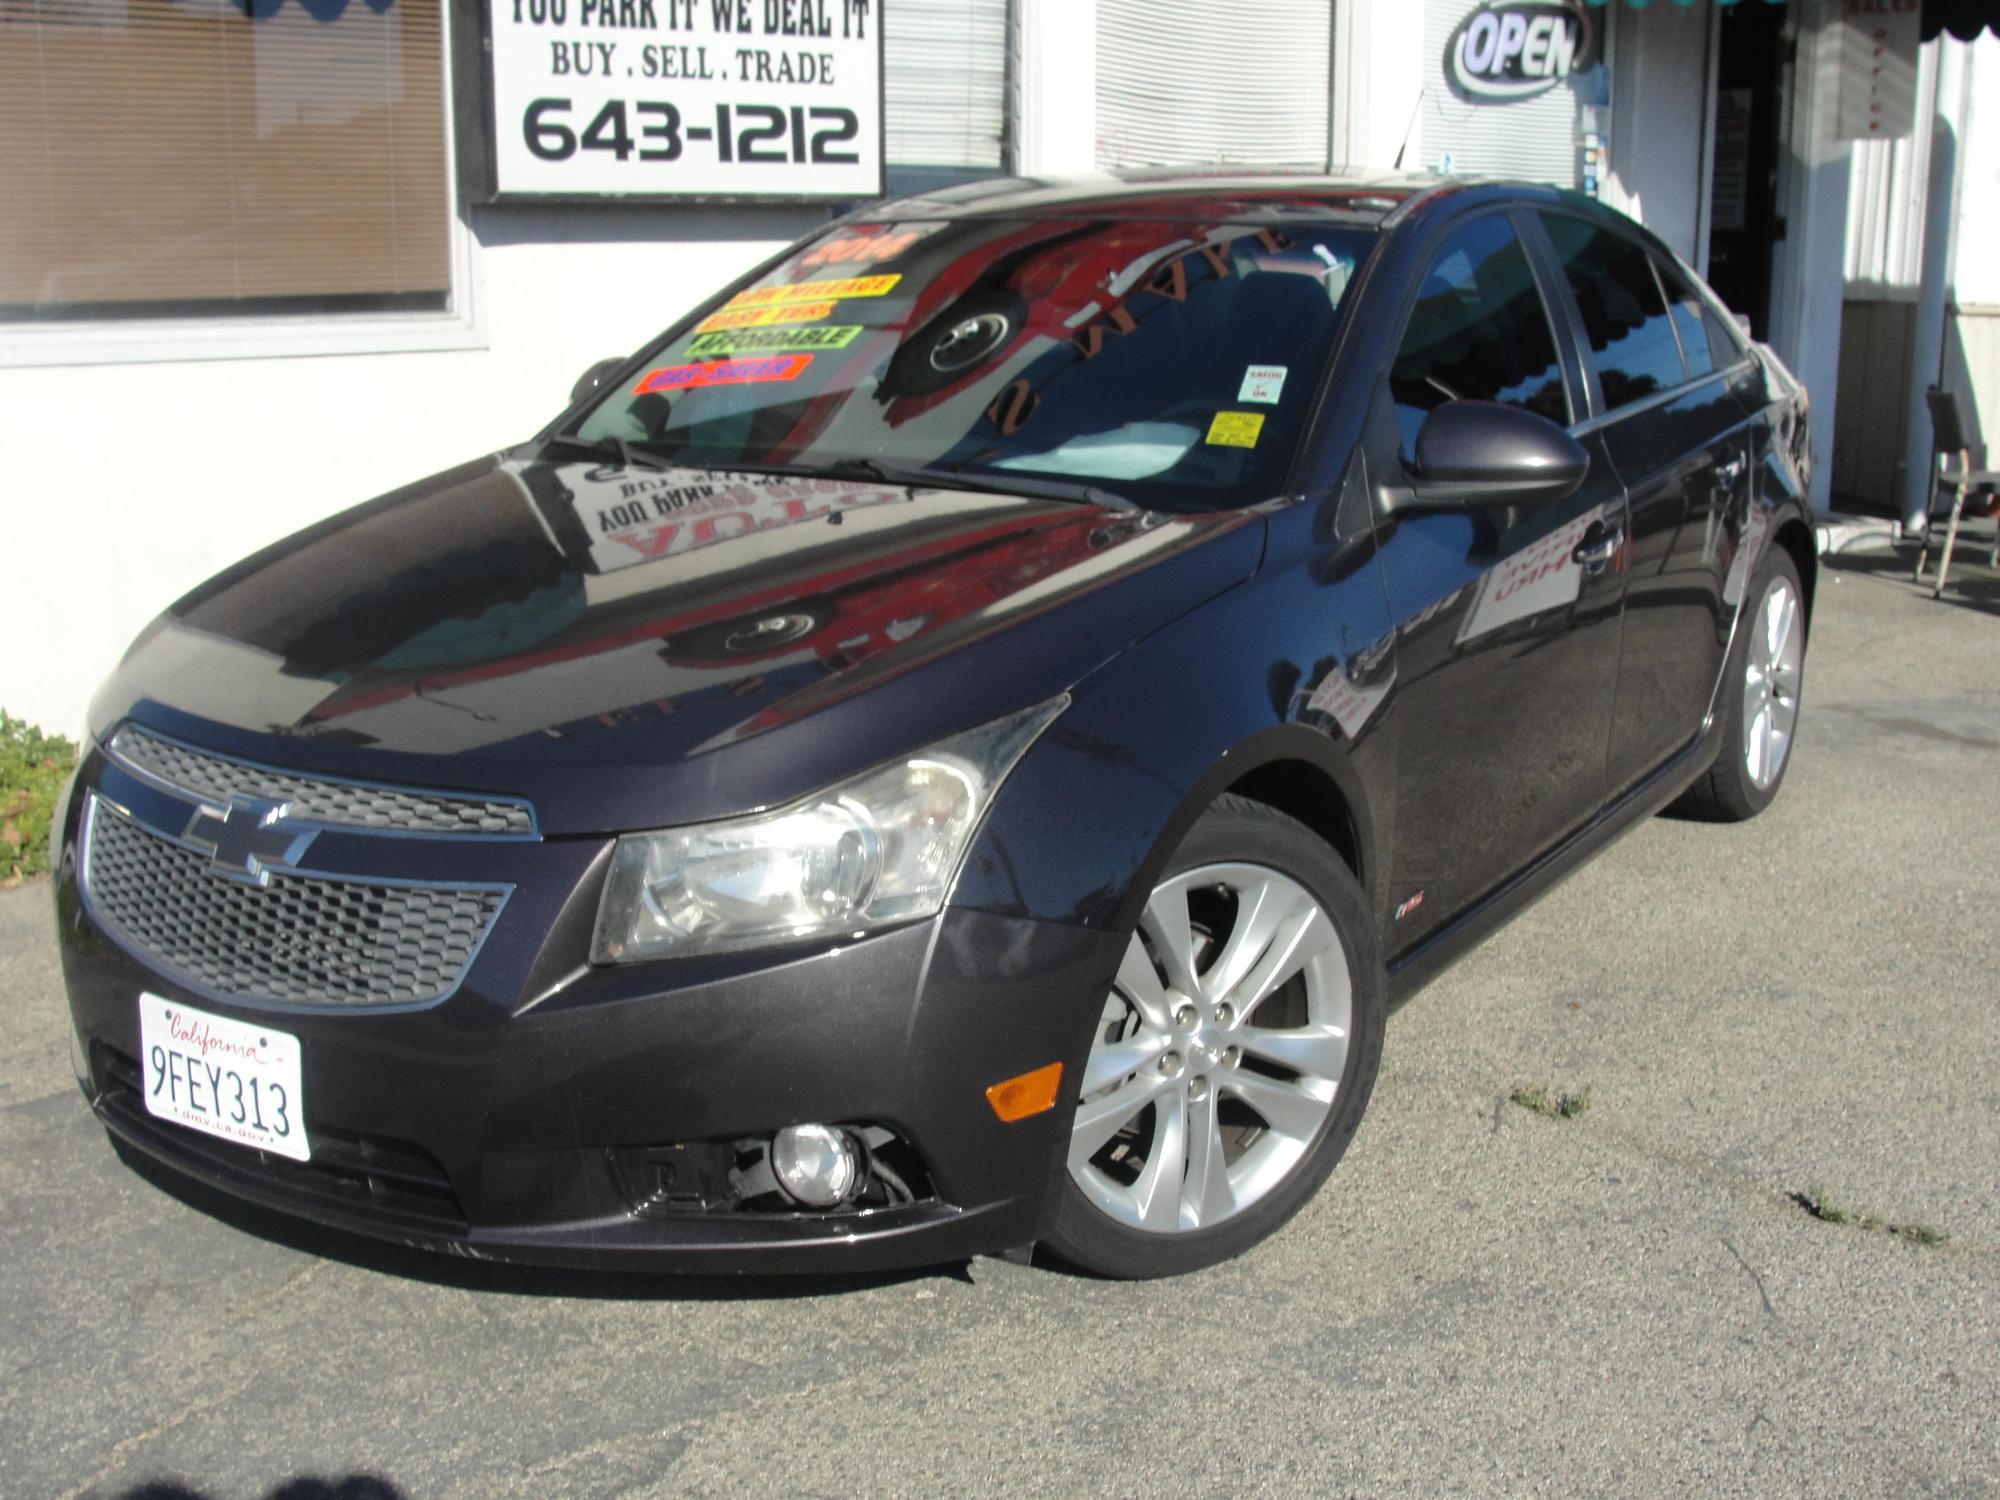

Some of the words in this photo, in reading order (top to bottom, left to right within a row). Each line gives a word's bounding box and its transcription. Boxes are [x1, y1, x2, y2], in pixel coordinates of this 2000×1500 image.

[511, 0, 567, 25] YOU
[580, 0, 658, 29] PARK
[669, 0, 697, 31] IT
[711, 0, 752, 33] WE
[763, 0, 832, 37] DEAL
[843, 0, 870, 39] IT
[1464, 11, 1578, 78] OPEN
[550, 41, 617, 76] BUY
[642, 44, 714, 79] SELL
[736, 48, 836, 85] TRADE
[522, 97, 860, 164] 643-1212
[170, 1012, 269, 1066] California
[151, 1045, 291, 1137] 9FEY313
